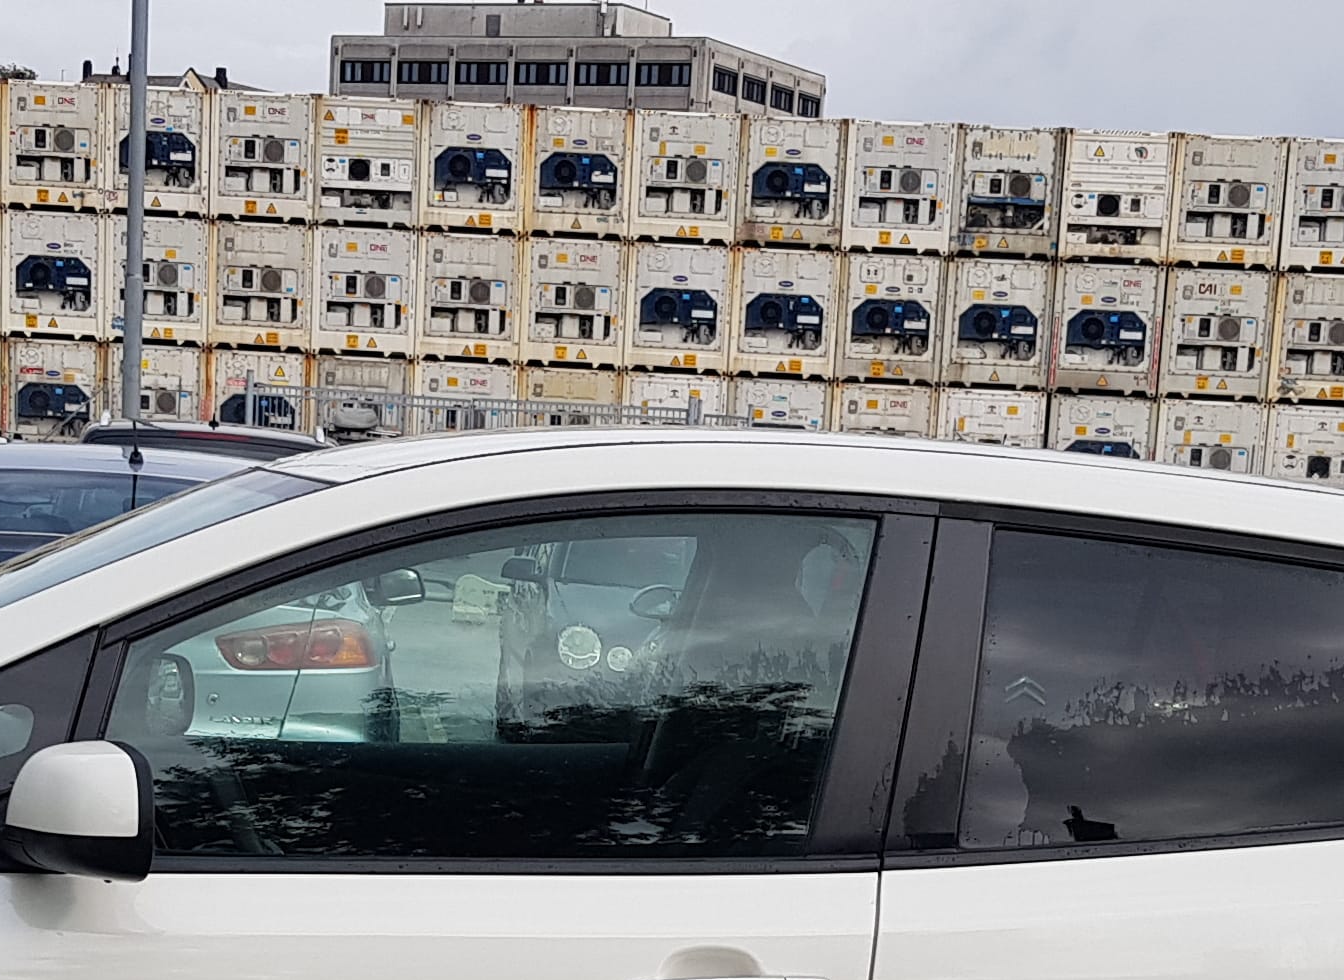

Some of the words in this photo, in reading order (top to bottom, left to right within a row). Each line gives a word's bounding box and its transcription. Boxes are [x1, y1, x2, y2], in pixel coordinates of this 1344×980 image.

[267, 107, 288, 116] ONE
[906, 137, 926, 146] ONE
[579, 255, 598, 264] ONE
[1123, 280, 1143, 289] ONE
[1199, 283, 1217, 295] CAI
[469, 379, 488, 387] ONE
